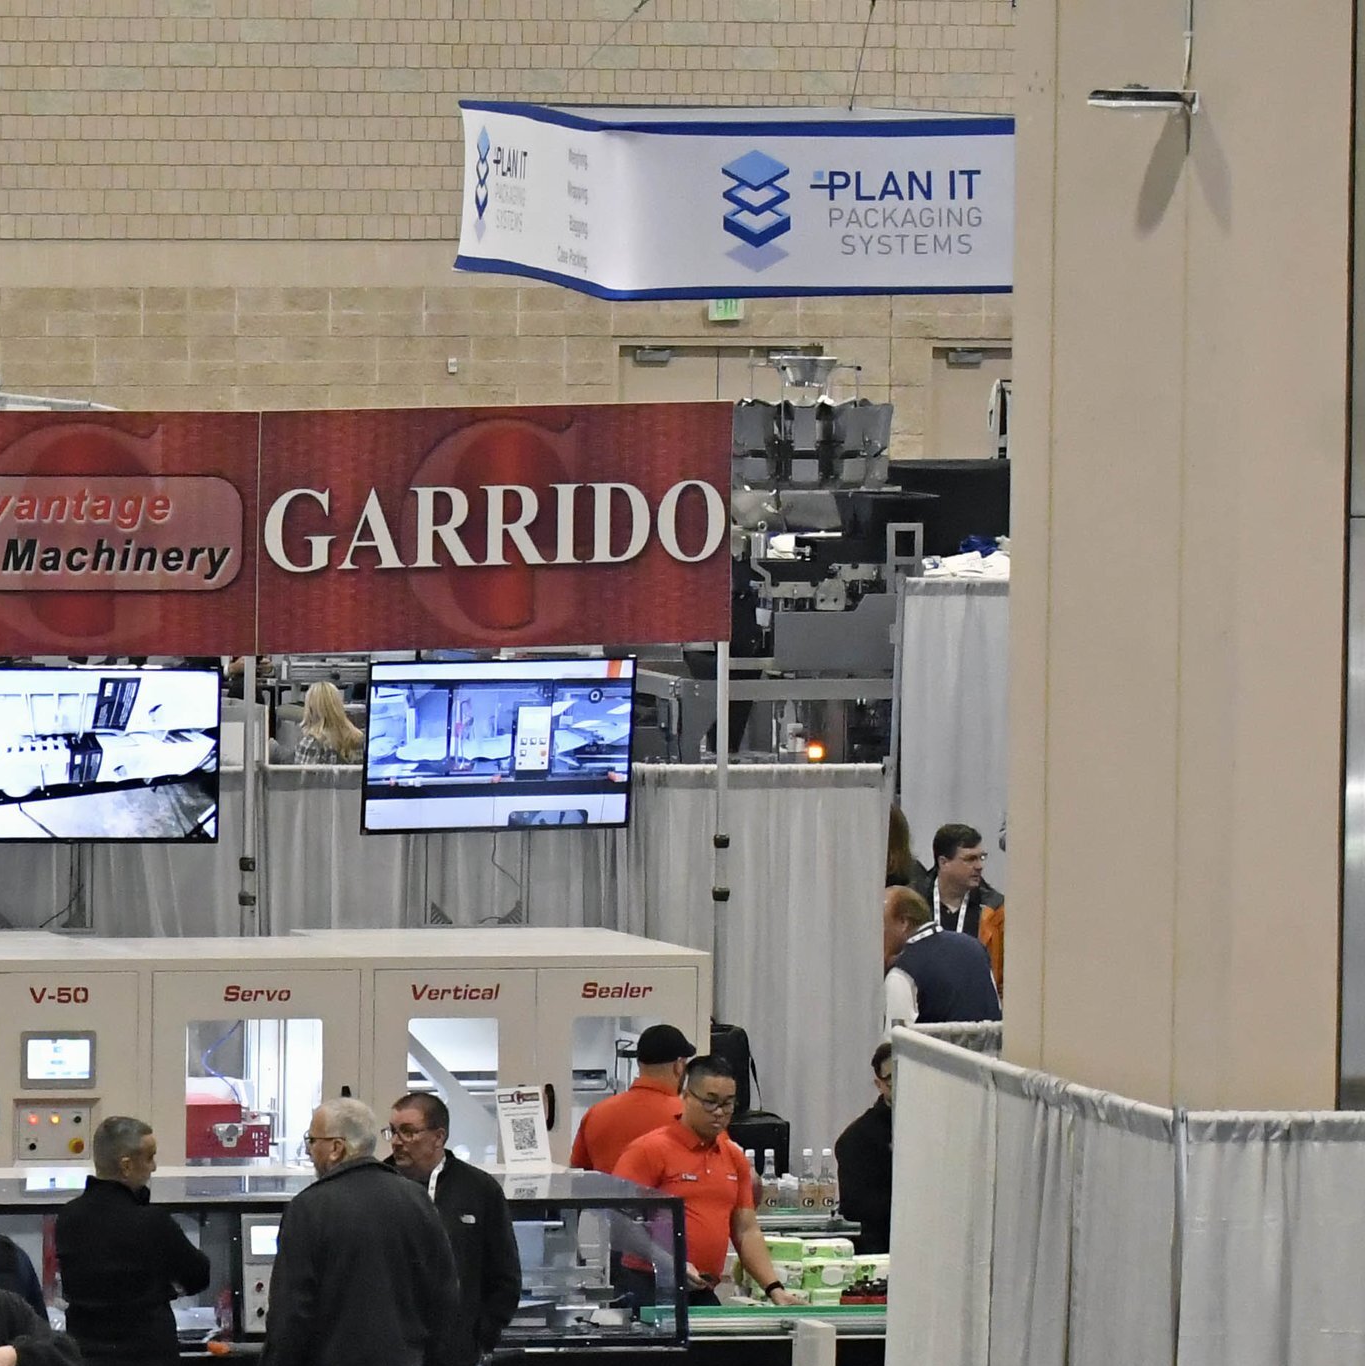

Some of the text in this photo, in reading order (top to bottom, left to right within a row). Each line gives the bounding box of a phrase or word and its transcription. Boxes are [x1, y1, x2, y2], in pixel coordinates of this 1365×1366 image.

[826, 169, 982, 202] PLAN IT
[827, 206, 983, 229] PACKAGING
[840, 233, 974, 256] SYSTEMS
[264, 478, 727, 574] GARRIDO
[1, 536, 233, 581] Machinery
[29, 986, 89, 1005] V-50
[223, 984, 291, 1003] Servo
[411, 983, 501, 1001] Vertical
[581, 981, 653, 999] Sealer
